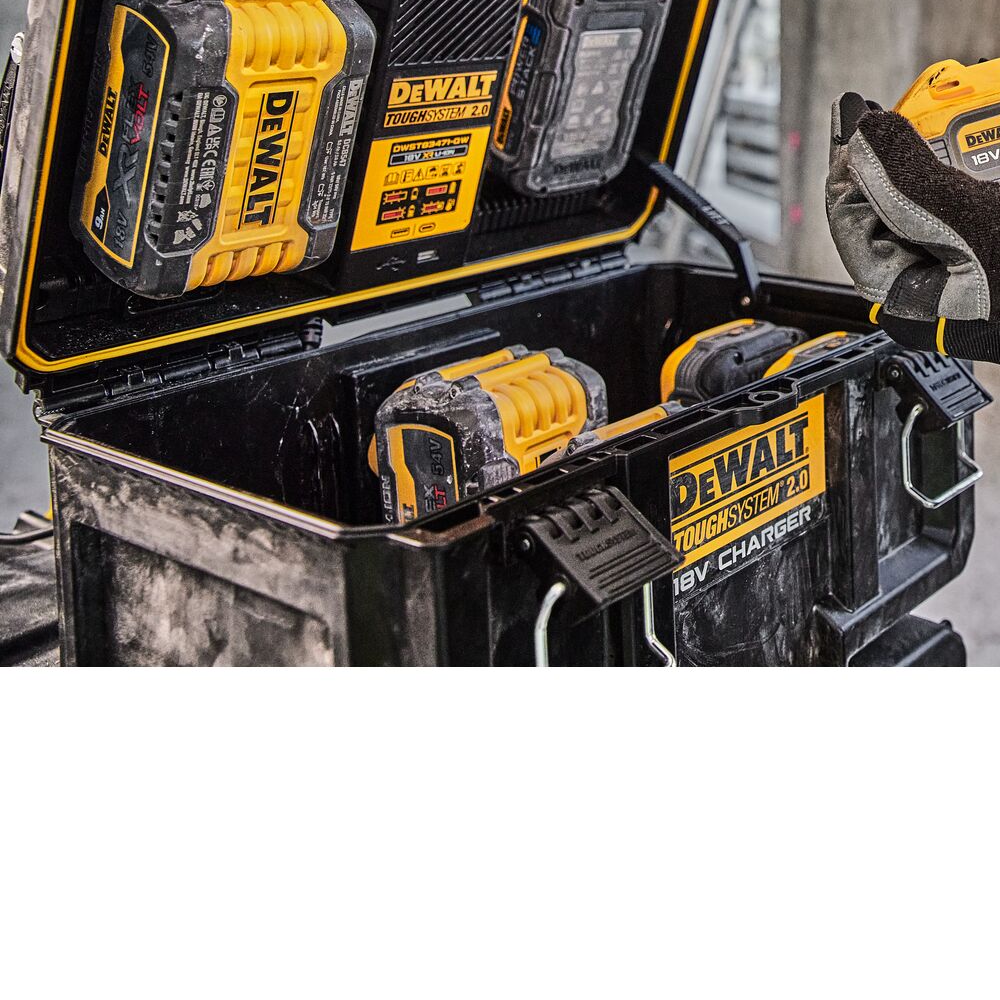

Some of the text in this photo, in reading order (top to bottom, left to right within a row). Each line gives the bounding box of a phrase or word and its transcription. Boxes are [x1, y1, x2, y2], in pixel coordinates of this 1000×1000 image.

[130, 82, 151, 144] VOLT
[339, 79, 363, 136] DEWALT
[386, 104, 489, 126] TOUGHSYSTEM 2.0
[388, 73, 497, 106] DEWALT
[98, 90, 119, 157] DEWALT
[244, 91, 294, 225] DEWALT
[971, 149, 1000, 165] 18V
[429, 439, 444, 475] 54V
[671, 417, 809, 518] DEWALT
[786, 469, 809, 498] 2.0
[673, 504, 812, 596] 18V CHARGER
